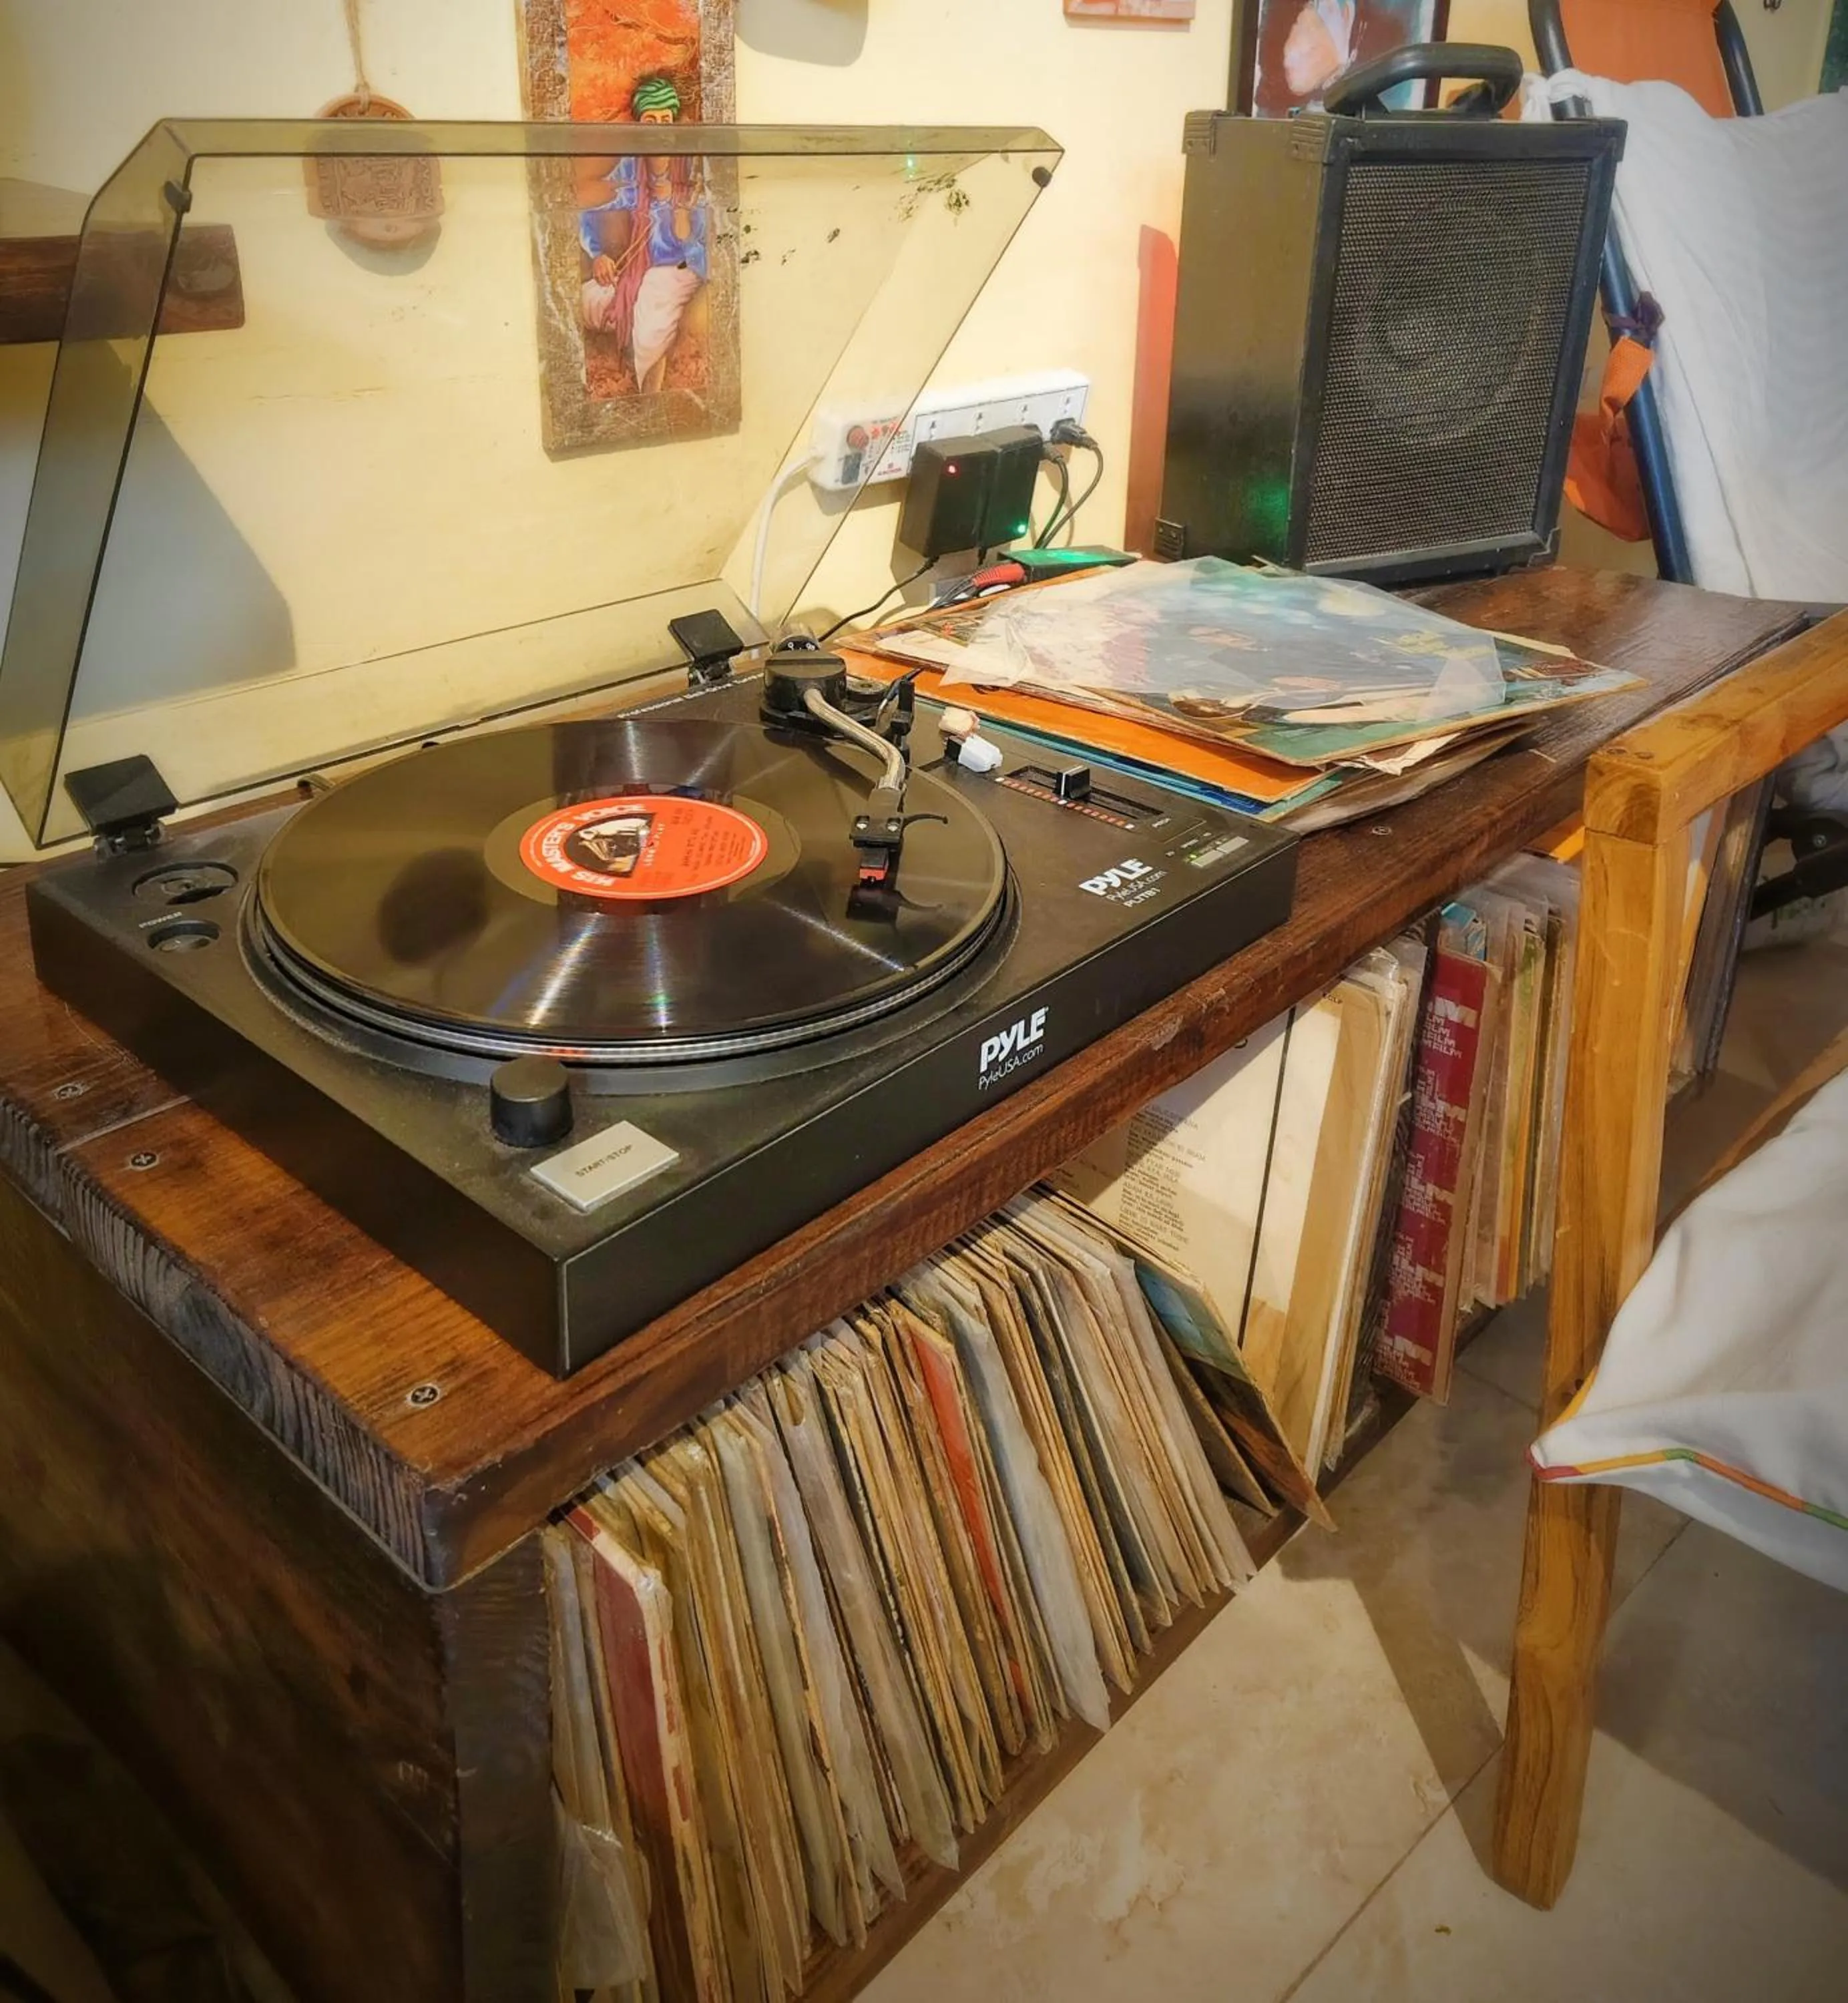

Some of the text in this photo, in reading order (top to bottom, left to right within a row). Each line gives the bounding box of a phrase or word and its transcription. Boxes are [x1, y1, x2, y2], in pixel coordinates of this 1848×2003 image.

[572, 804, 647, 822] VOICE
[570, 871, 616, 887] HIS
[1079, 858, 1154, 896] PYLE
[1106, 870, 1168, 901] PyleUSA.com
[979, 1006, 1048, 1073] PYLE
[978, 1043, 1044, 1090] PyleUSA.com
[575, 1144, 632, 1177] START/STOP
